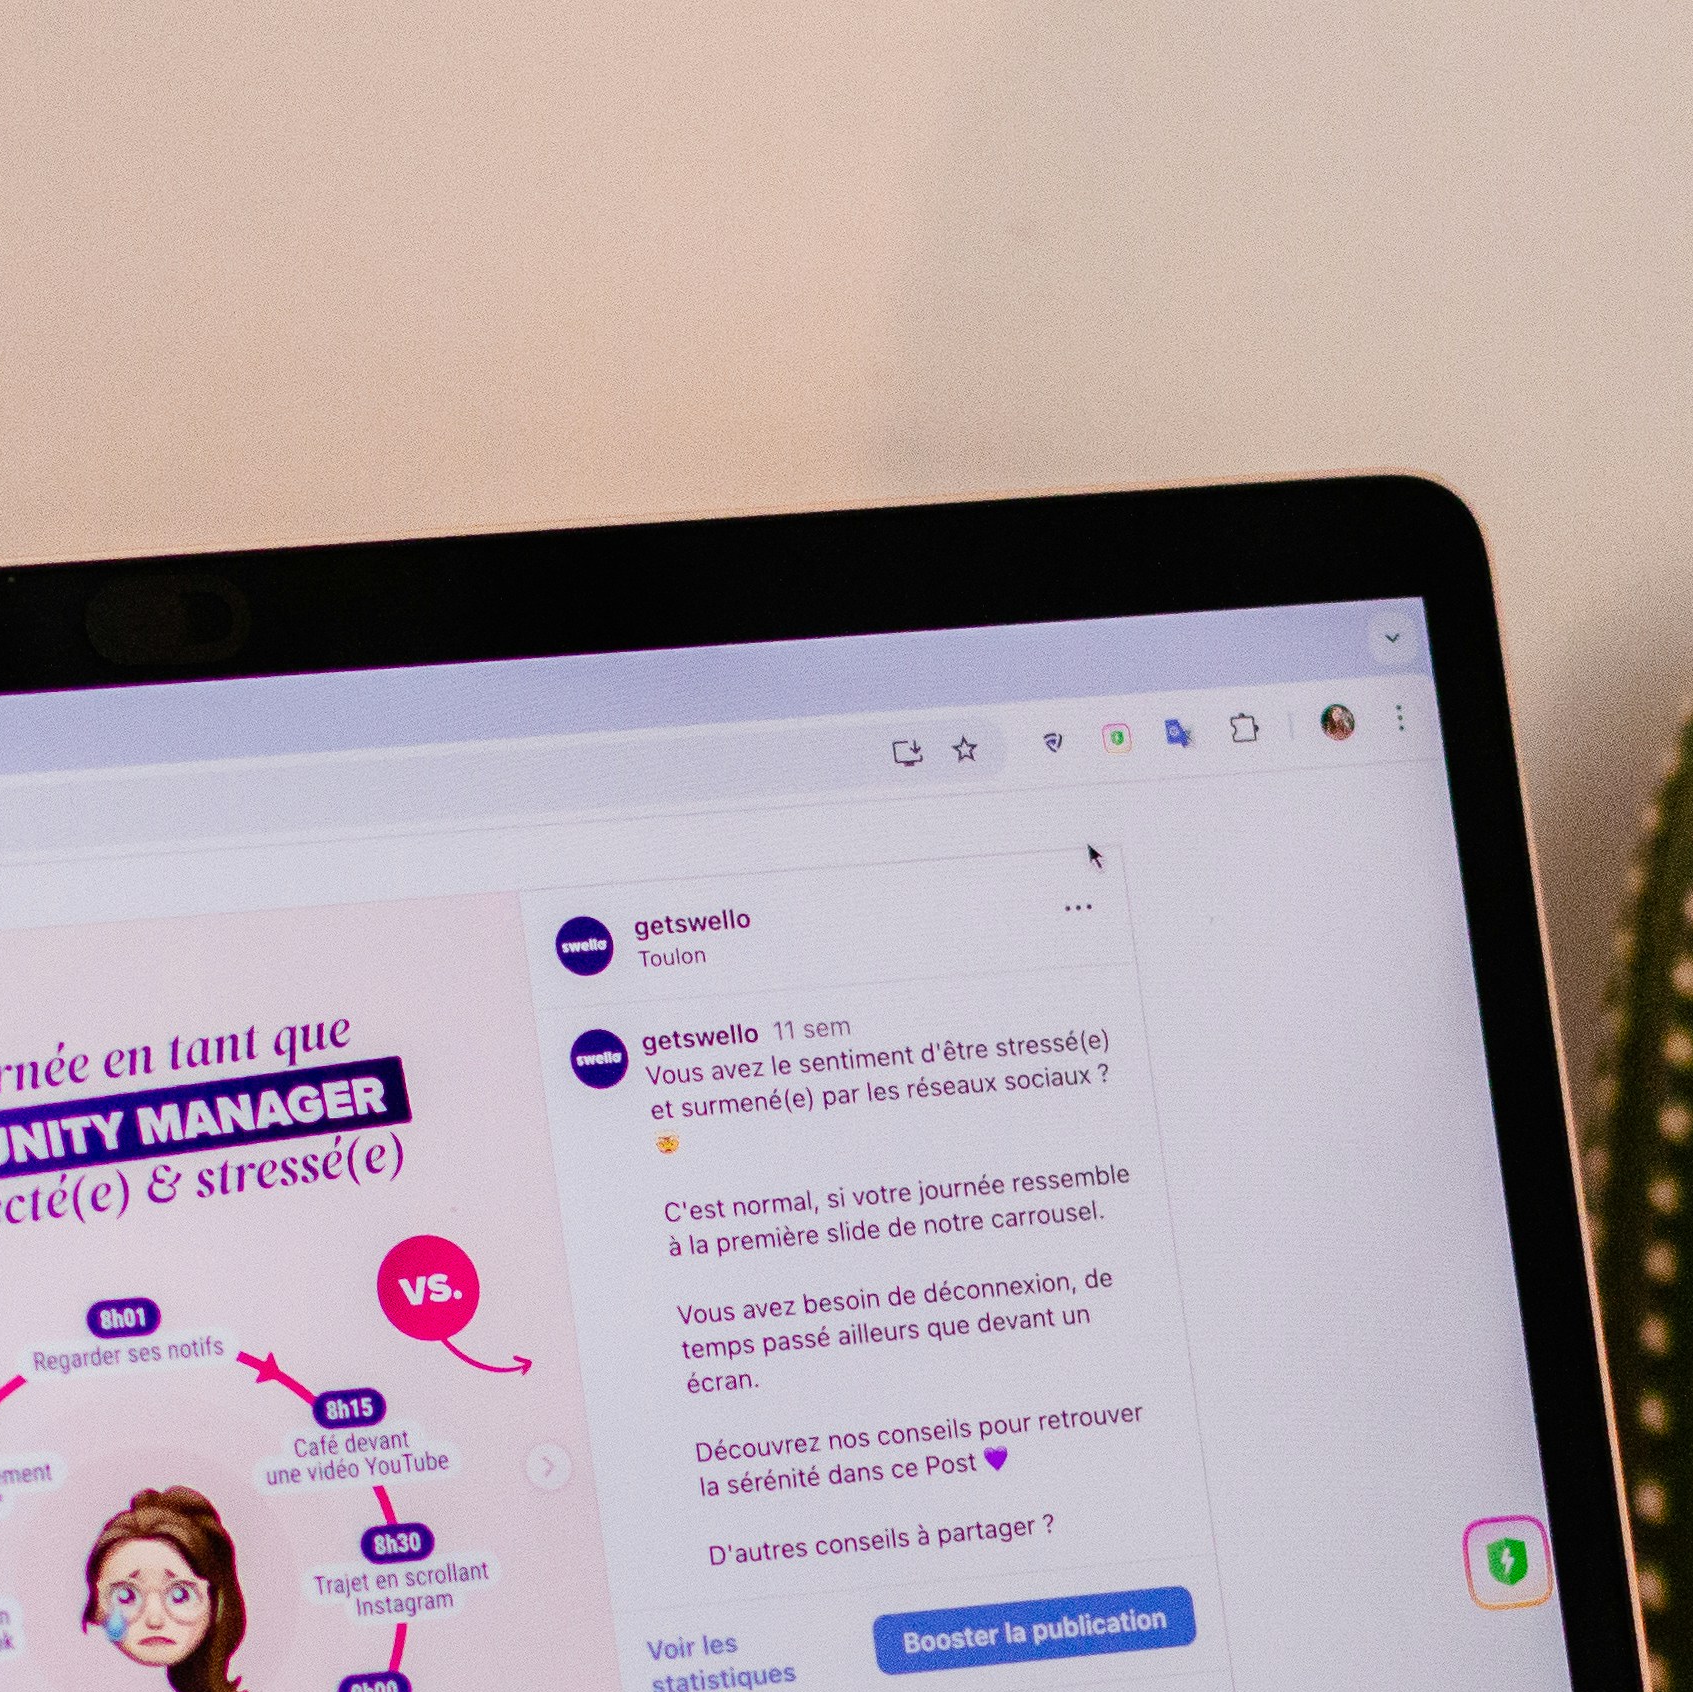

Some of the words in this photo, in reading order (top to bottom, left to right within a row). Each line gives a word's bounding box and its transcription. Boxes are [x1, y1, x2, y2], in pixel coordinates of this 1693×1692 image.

[633, 908, 752, 942] getswello
[637, 947, 708, 969] Toulon
[102, 1044, 154, 1080] en
[169, 1025, 257, 1072] tant
[272, 1017, 352, 1068] que
[640, 1022, 760, 1058] getswello
[772, 1018, 796, 1042] 11
[802, 1018, 852, 1040] sem
[644, 1064, 706, 1087] Vous
[710, 1060, 765, 1082] avez
[770, 1054, 793, 1077] le
[797, 1045, 915, 1075] sentiment
[919, 1037, 989, 1065] d'être
[995, 1028, 1111, 1058] stressé(e)
[136, 1076, 388, 1146] MANAGER
[649, 1099, 675, 1121] et
[680, 1086, 815, 1119] surmené(e)
[821, 1087, 860, 1111] par
[865, 1080, 902, 1103] les
[905, 1075, 998, 1099] réseaux
[1003, 1068, 1092, 1092] sociaux
[145, 1163, 183, 1205] &
[195, 1132, 405, 1200] stressé(e)
[662, 1198, 727, 1224] C'est
[731, 1189, 820, 1218] normal,
[825, 1191, 847, 1210] si
[851, 1184, 912, 1208] votre
[917, 1172, 1007, 1207] journée
[1010, 1163, 1131, 1194] ressemble
[667, 1234, 684, 1259] à
[687, 1233, 711, 1257] la
[714, 1224, 821, 1259] première
[825, 1218, 882, 1245] slide
[886, 1215, 918, 1240] de
[922, 1212, 985, 1236] notre
[989, 1198, 1105, 1231] carrousel.
[676, 1304, 737, 1326] Vous
[742, 1298, 796, 1321] avez
[801, 1291, 882, 1316] besoin
[886, 1284, 917, 1308] de
[922, 1275, 1077, 1305] déconnexion,
[1083, 1267, 1114, 1291] de
[98, 1306, 147, 1331] 8h01
[680, 1337, 756, 1361] temps
[761, 1324, 832, 1359] passé
[837, 1322, 921, 1347] ailleurs
[926, 1317, 971, 1344] que
[976, 1307, 1057, 1334] devant
[1061, 1307, 1092, 1327] un
[31, 1345, 122, 1377] Regarder
[125, 1344, 164, 1365] ses
[166, 1334, 226, 1361] notifs
[685, 1369, 760, 1396] écran.
[325, 1395, 375, 1421] 8h15
[292, 1434, 339, 1460] Café
[343, 1429, 410, 1454] devant
[694, 1435, 821, 1464] Découvrez
[827, 1430, 872, 1451] nos
[875, 1417, 973, 1447] conseils
[977, 1415, 1032, 1442] pour
[1037, 1405, 1144, 1432] retrouver
[265, 1466, 303, 1488] une
[306, 1458, 361, 1482] vidéo
[363, 1450, 451, 1477] YouTube
[698, 1476, 722, 1498] la
[726, 1463, 822, 1496] sérénité
[826, 1463, 885, 1486] dans
[889, 1461, 919, 1481] ce
[924, 1452, 978, 1476] Post
[373, 1530, 423, 1556] 8h30
[707, 1540, 810, 1568] D'autres
[813, 1527, 912, 1557] conseils
[916, 1522, 931, 1548] à
[936, 1518, 1036, 1550] partager
[313, 1572, 371, 1599] Trajet
[374, 1571, 401, 1592] en
[403, 1561, 490, 1589] scrollant
[355, 1591, 455, 1619] Instagram
[645, 1636, 696, 1663] Voir
[701, 1633, 739, 1658] les
[902, 1626, 1000, 1655] Booster
[1003, 1621, 1028, 1644] la
[1031, 1608, 1168, 1646] publication
